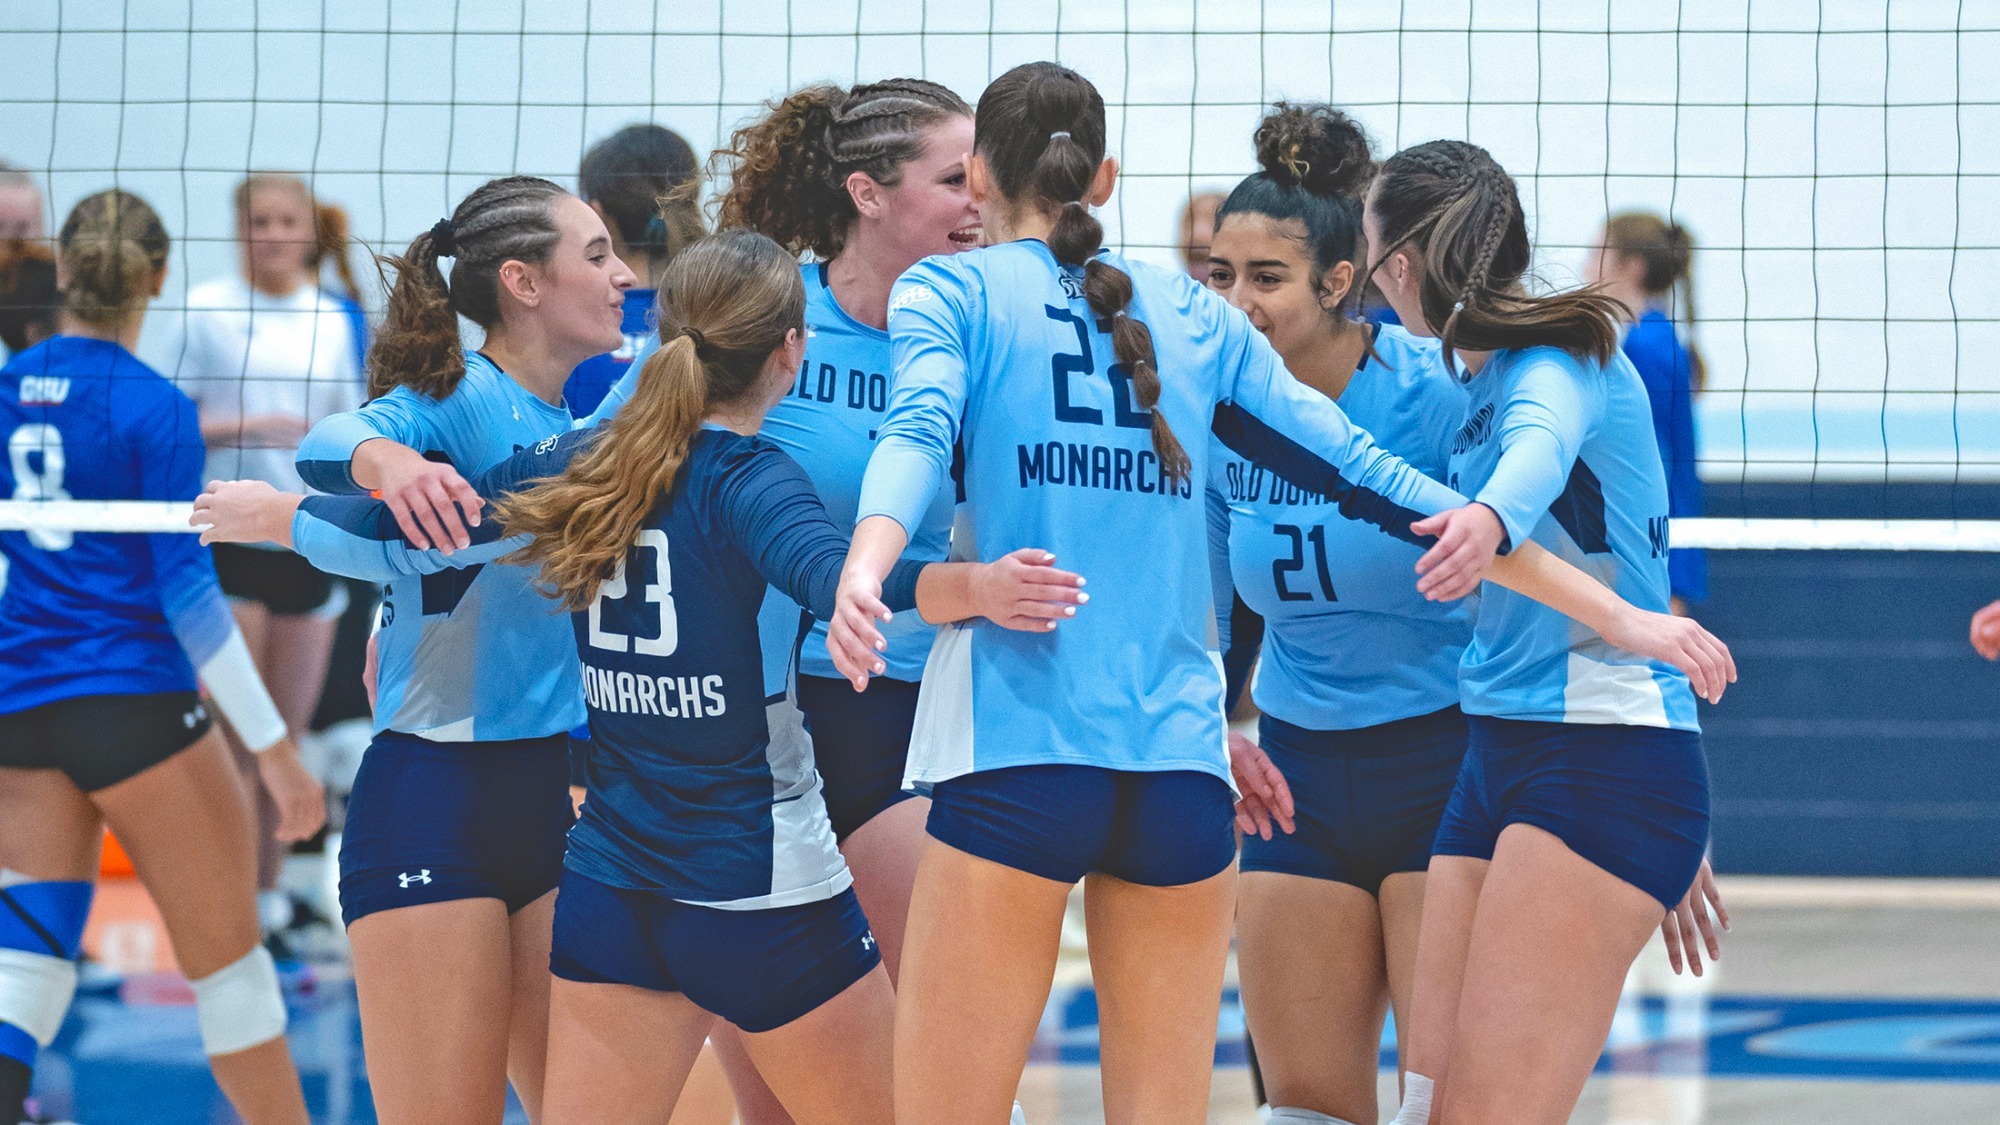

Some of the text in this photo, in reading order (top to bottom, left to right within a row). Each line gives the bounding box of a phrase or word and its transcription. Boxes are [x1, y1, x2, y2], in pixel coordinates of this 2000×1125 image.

[786, 359, 836, 404] LD
[1226, 462, 1263, 503] OLD
[589, 529, 678, 657] 23
[1272, 523, 1338, 602] 21
